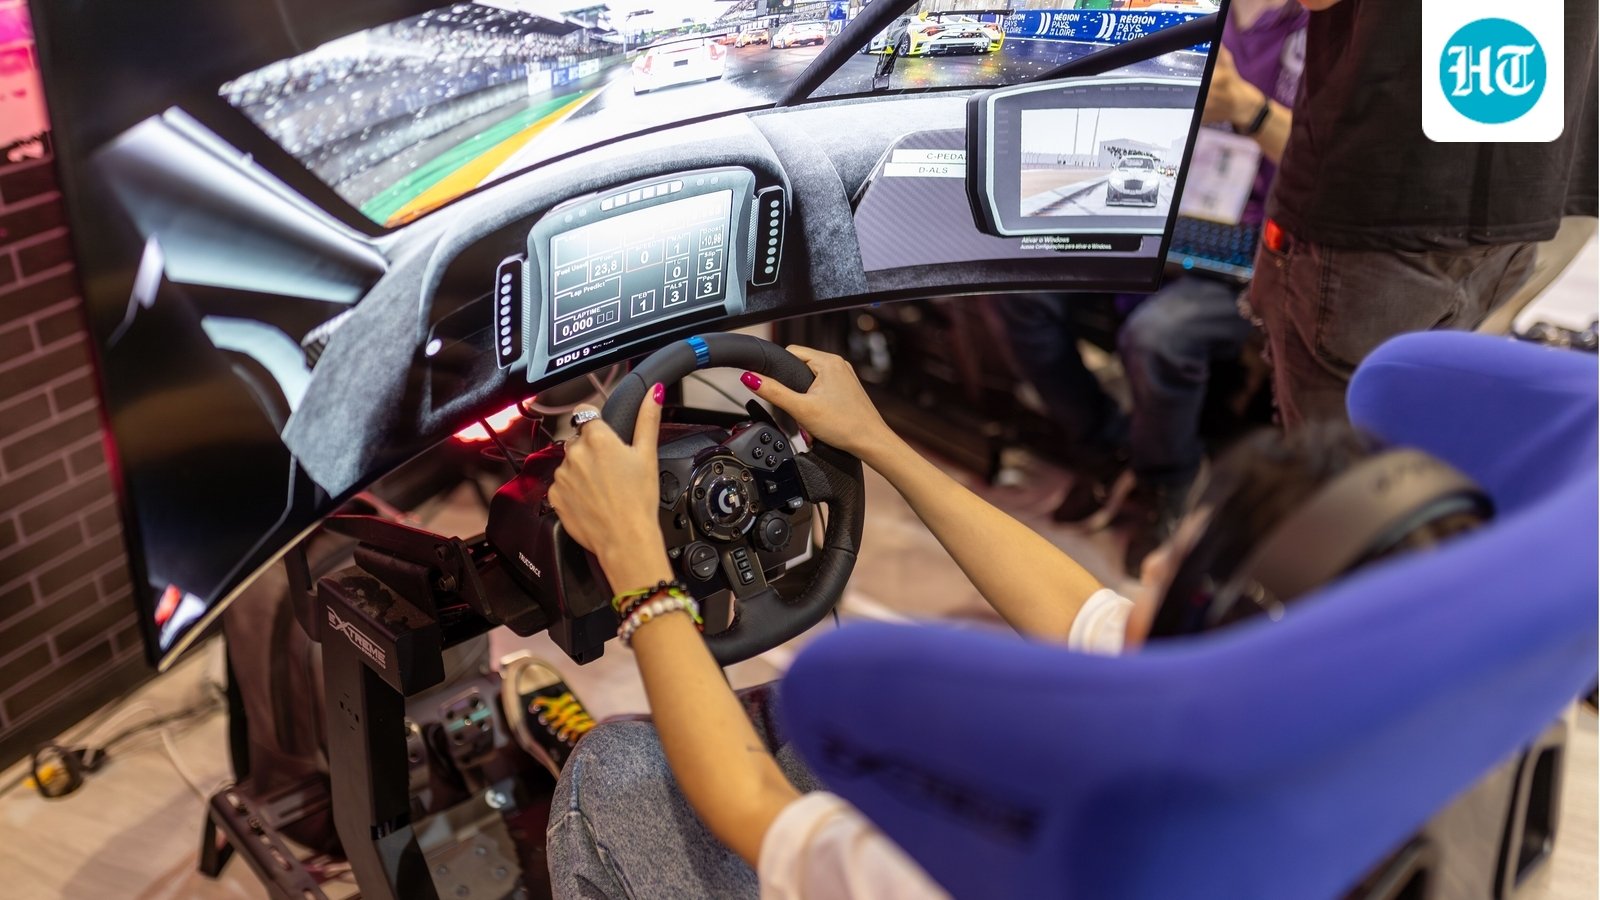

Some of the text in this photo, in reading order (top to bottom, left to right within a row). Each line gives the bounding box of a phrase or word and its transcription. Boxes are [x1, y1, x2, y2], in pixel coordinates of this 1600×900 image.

[1053, 13, 1080, 21] RÉGION
[1120, 14, 1156, 25] RÉGION
[1051, 20, 1070, 28] PAYS
[1117, 23, 1142, 32] PAYS
[1055, 28, 1076, 36] LOIRE
[918, 166, 948, 174] D-ALS
[673, 242, 680, 254] 1
[640, 250, 649, 264] 0
[594, 260, 618, 277] 23,8
[705, 258, 714, 270] 5
[672, 266, 682, 278] 0
[570, 282, 606, 298] Lap Predict
[669, 281, 683, 291] ALS
[703, 281, 713, 294] 3
[670, 290, 680, 303] 3
[639, 298, 647, 311] 1
[573, 308, 601, 321] LAPTIME
[562, 316, 594, 337] 0,000
[556, 347, 591, 367] DDU 9
[326, 605, 386, 666] EXTREME
